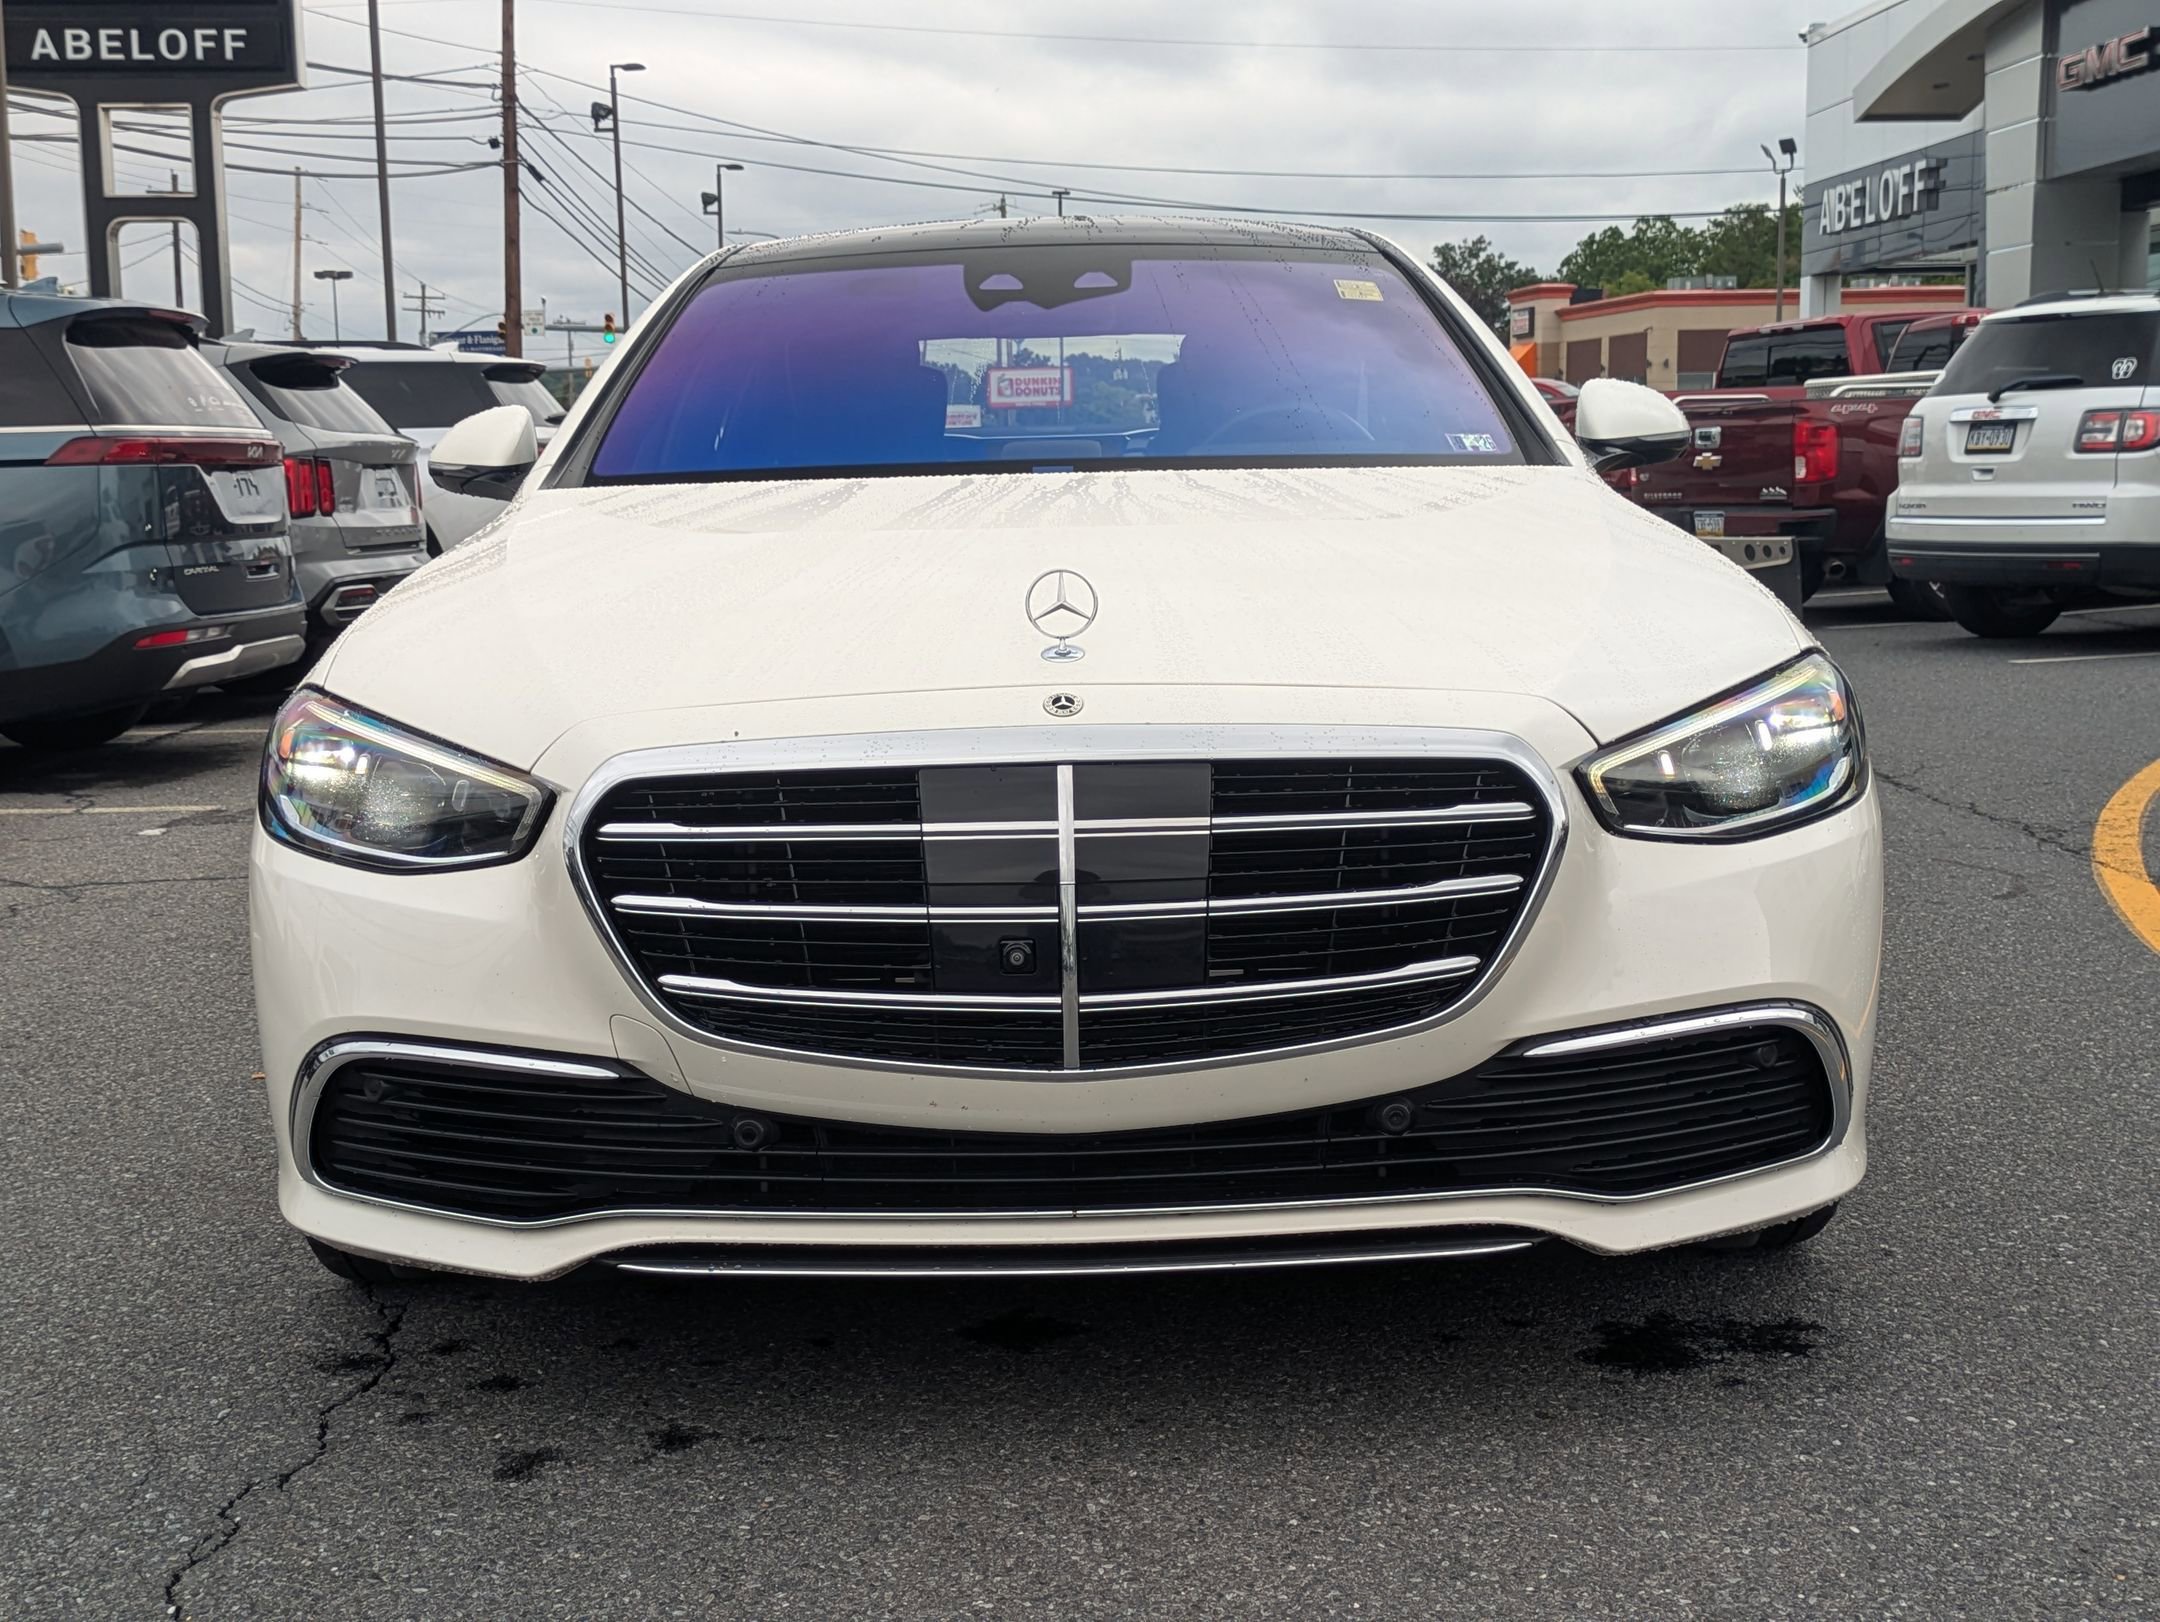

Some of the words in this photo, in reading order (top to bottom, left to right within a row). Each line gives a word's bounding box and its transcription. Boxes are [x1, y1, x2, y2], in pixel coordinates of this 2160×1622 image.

[31, 29, 248, 61] ABELOFF
[2056, 26, 2149, 91] GMC
[1819, 159, 1928, 235] ABELOFF
